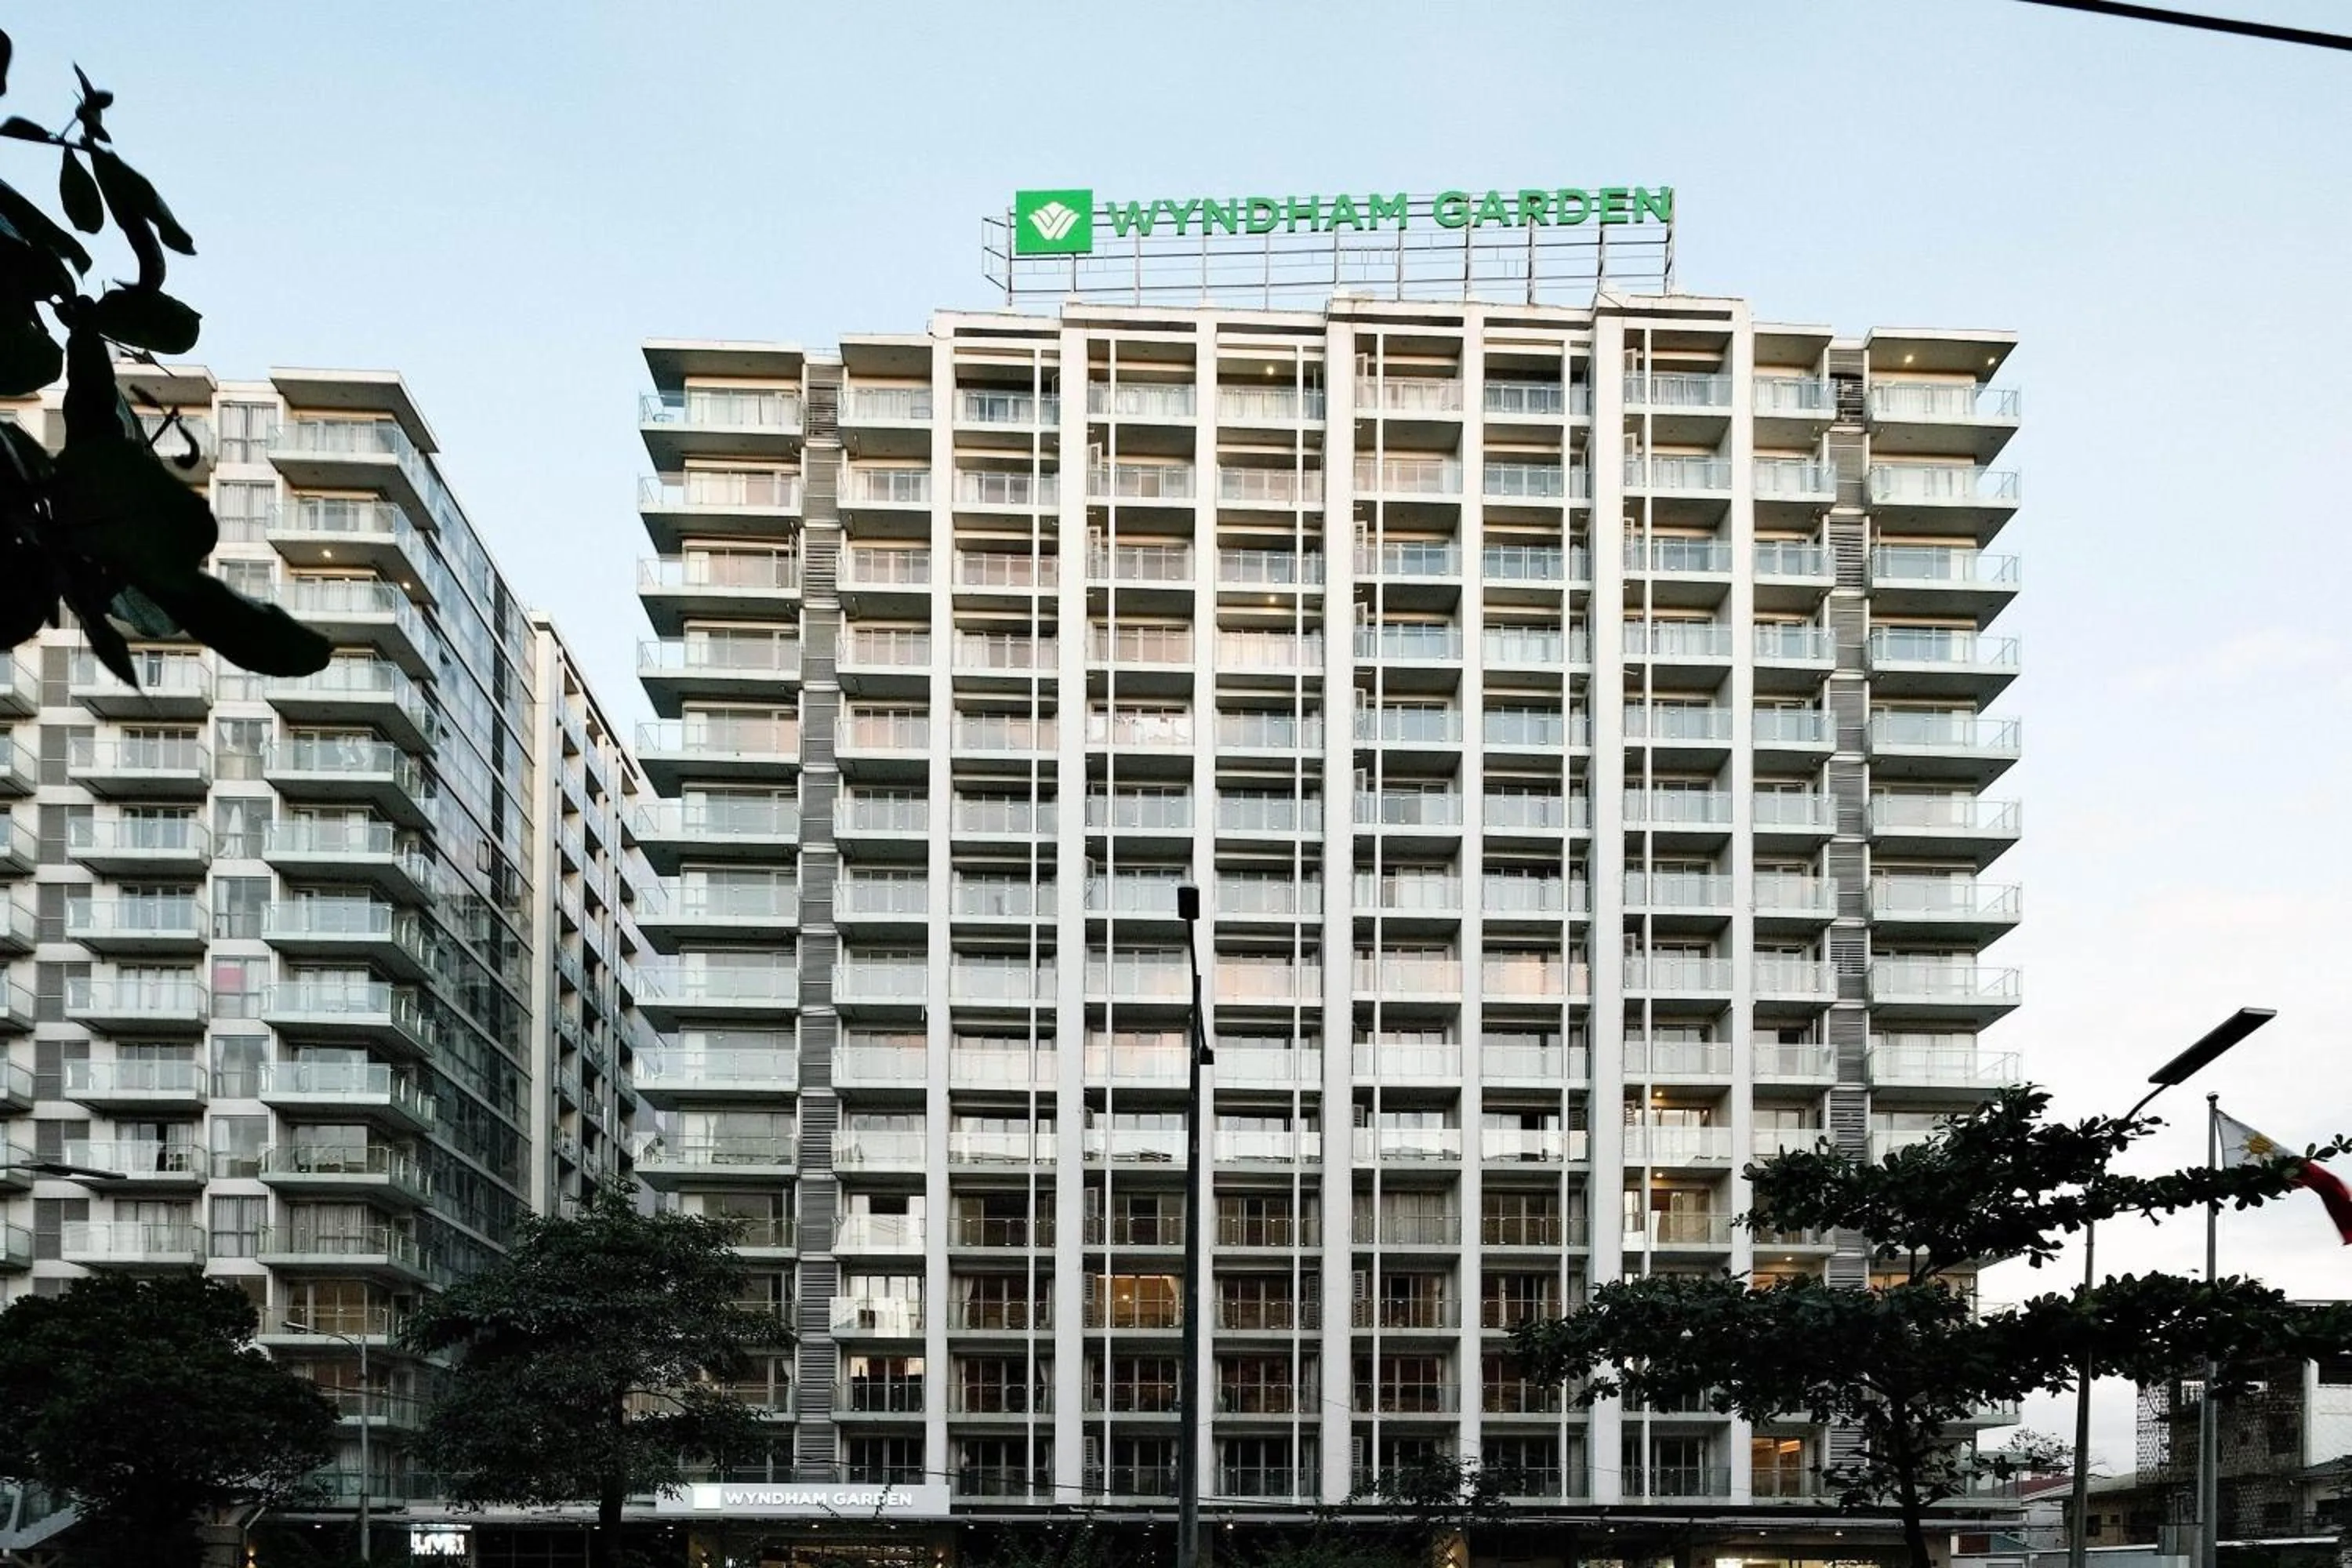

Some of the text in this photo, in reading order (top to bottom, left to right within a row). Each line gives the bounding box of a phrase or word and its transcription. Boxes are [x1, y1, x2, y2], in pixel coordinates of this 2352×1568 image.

[1105, 186, 1672, 237] WYNDHAM GARDEN
[725, 1491, 913, 1506] WYNDHAM GARDEN
